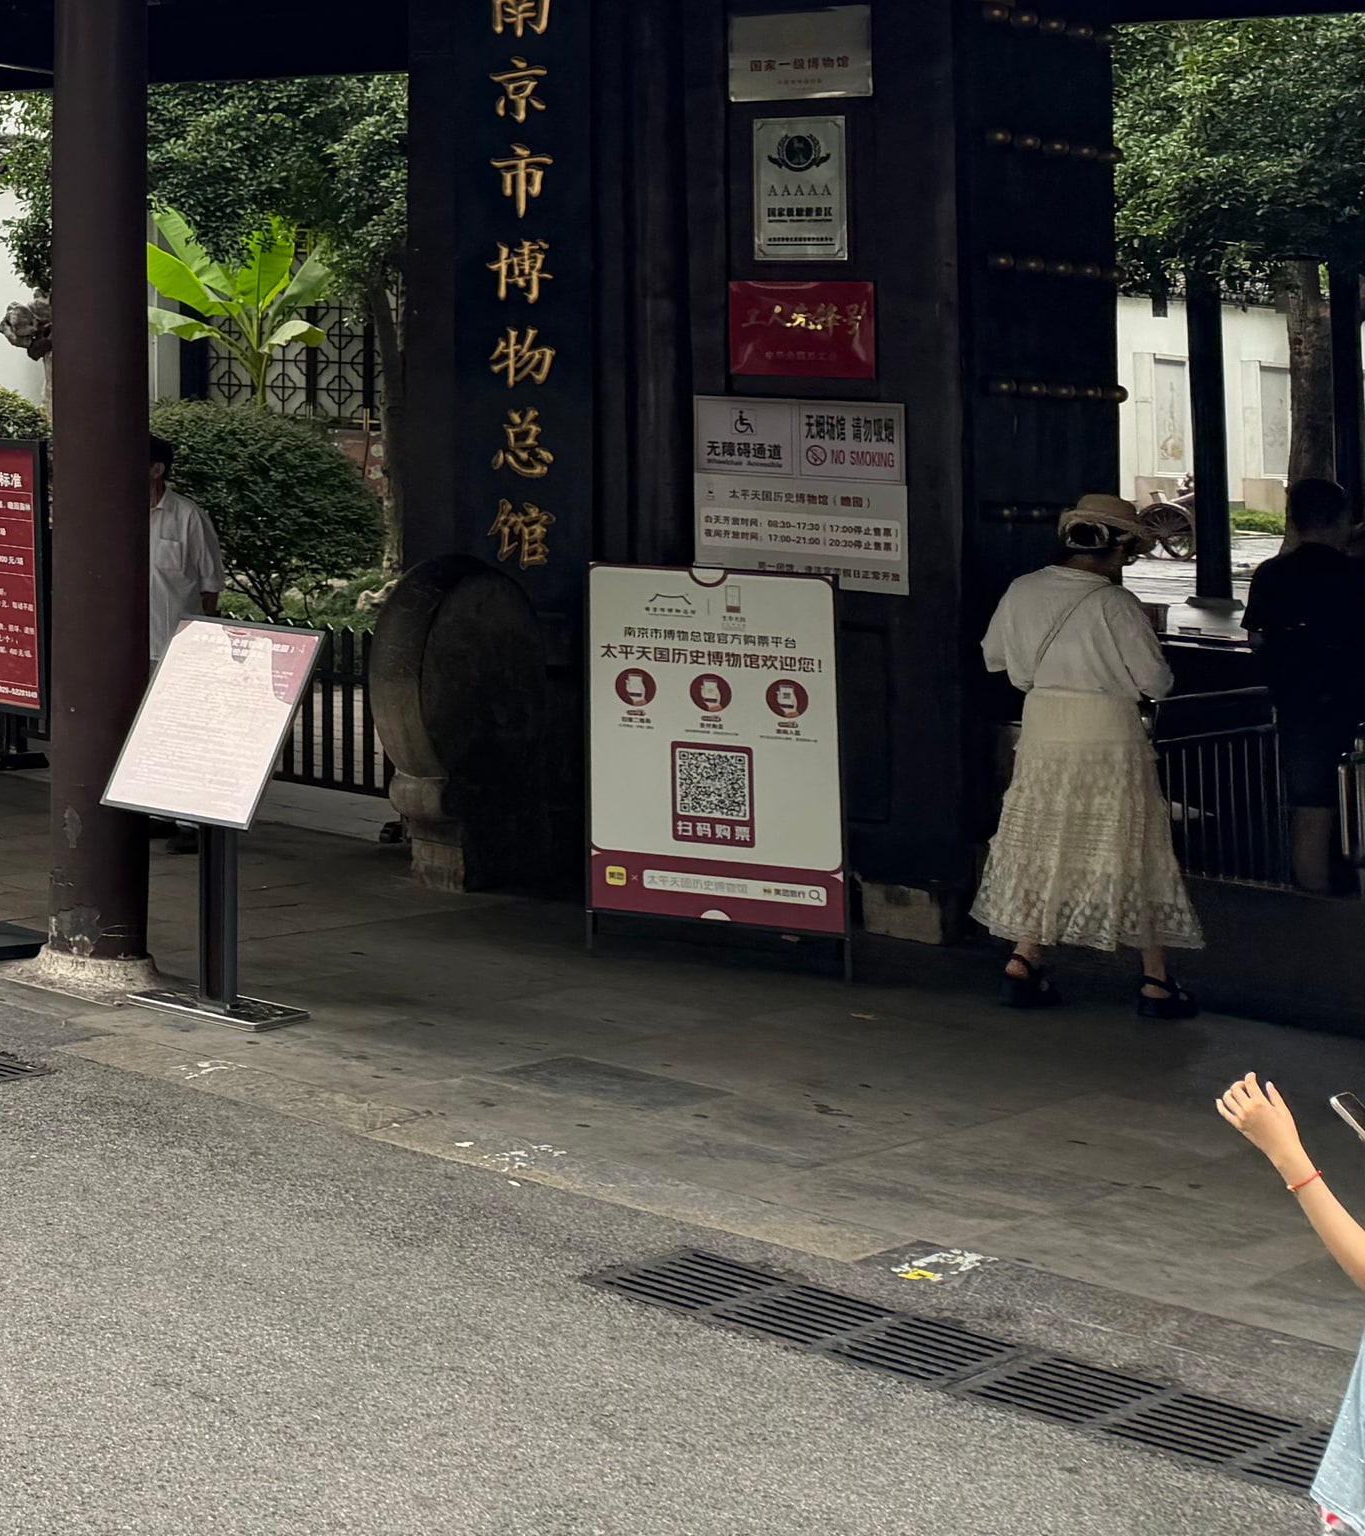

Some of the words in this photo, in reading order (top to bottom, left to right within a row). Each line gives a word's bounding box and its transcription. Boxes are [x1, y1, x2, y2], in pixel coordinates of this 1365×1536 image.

[750, 55, 849, 72] 国家一级博物馆
[768, 184, 832, 196] AAAAA
[806, 415, 846, 441] 无烟场馆
[851, 417, 894, 444] 请勿吸烟
[706, 441, 782, 460] 无障碍通道
[831, 450, 846, 465] NO
[850, 451, 895, 468] SMOKING
[624, 626, 797, 649] 南京市博物总馆官方购票平台
[601, 643, 823, 673] 太平天国历史博物馆欢迎您！
[676, 820, 752, 842] 扫码购票
